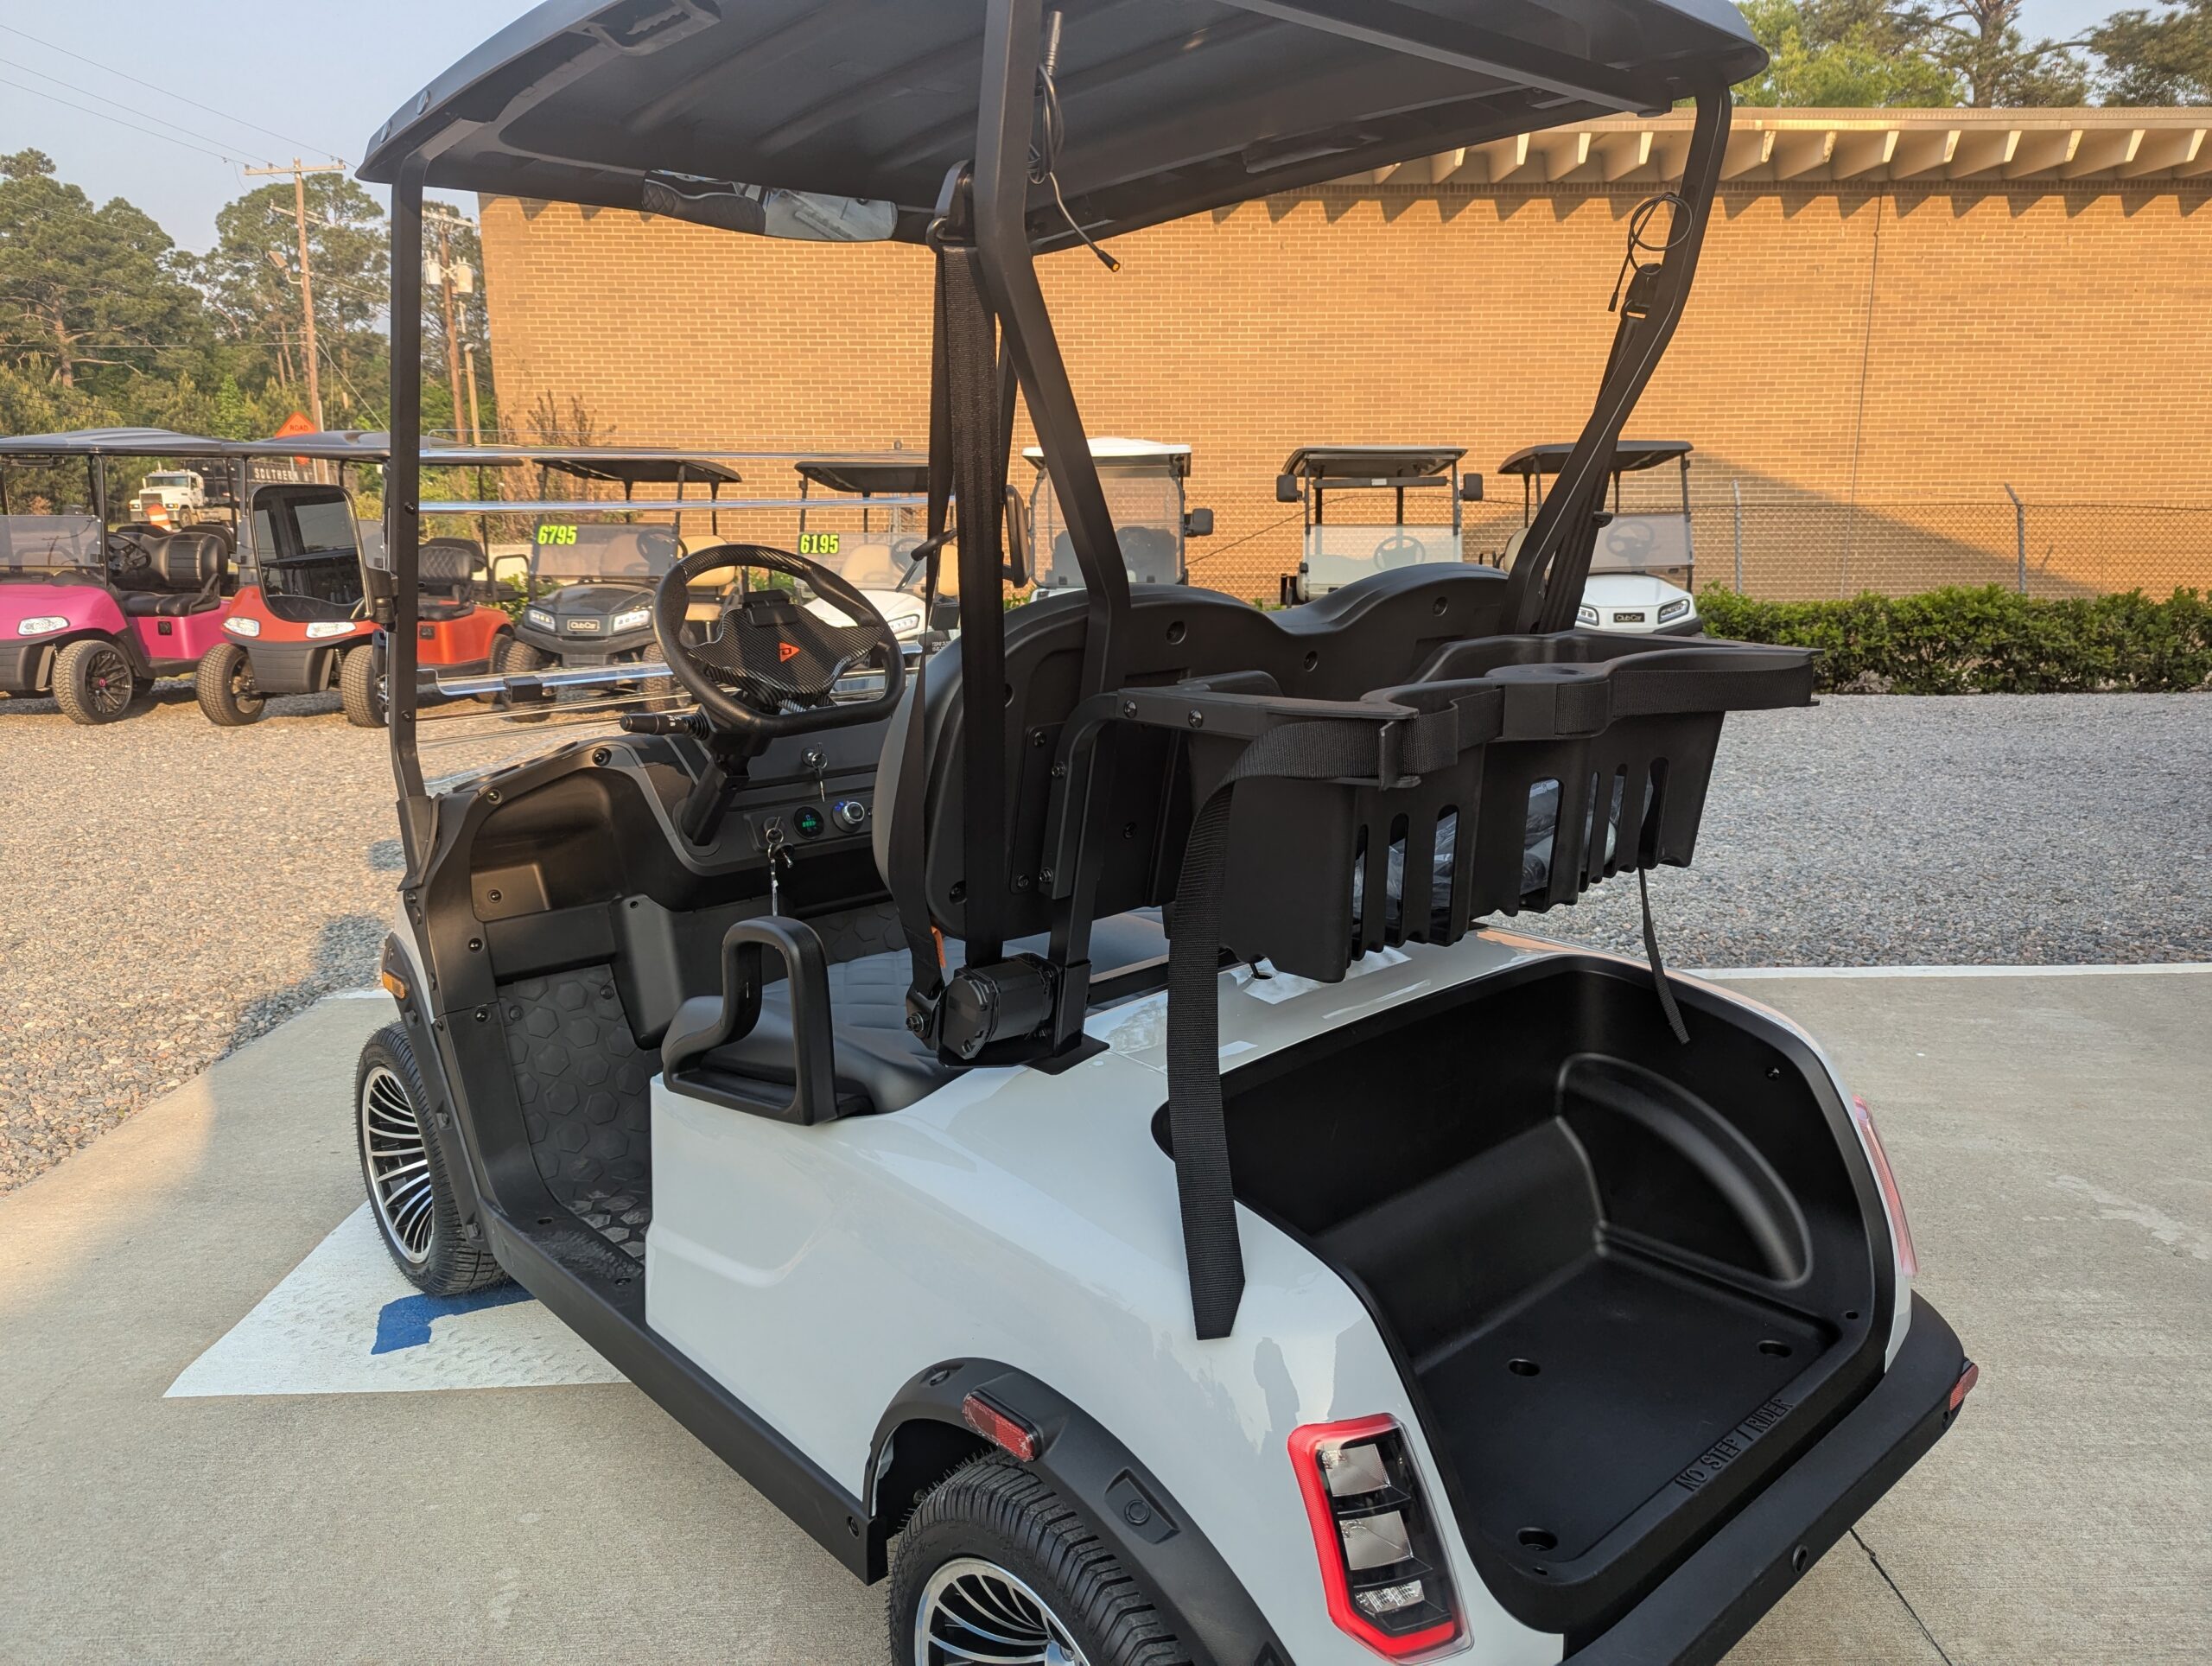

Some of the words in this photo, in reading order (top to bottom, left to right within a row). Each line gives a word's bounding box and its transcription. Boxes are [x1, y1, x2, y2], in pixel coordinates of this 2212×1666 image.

[537, 525, 577, 544] 6795
[800, 534, 839, 554] 6195
[1675, 1468, 1707, 1492] NO
[1700, 1438, 1742, 1471] STEP
[1744, 1398, 1794, 1434] RIDER
